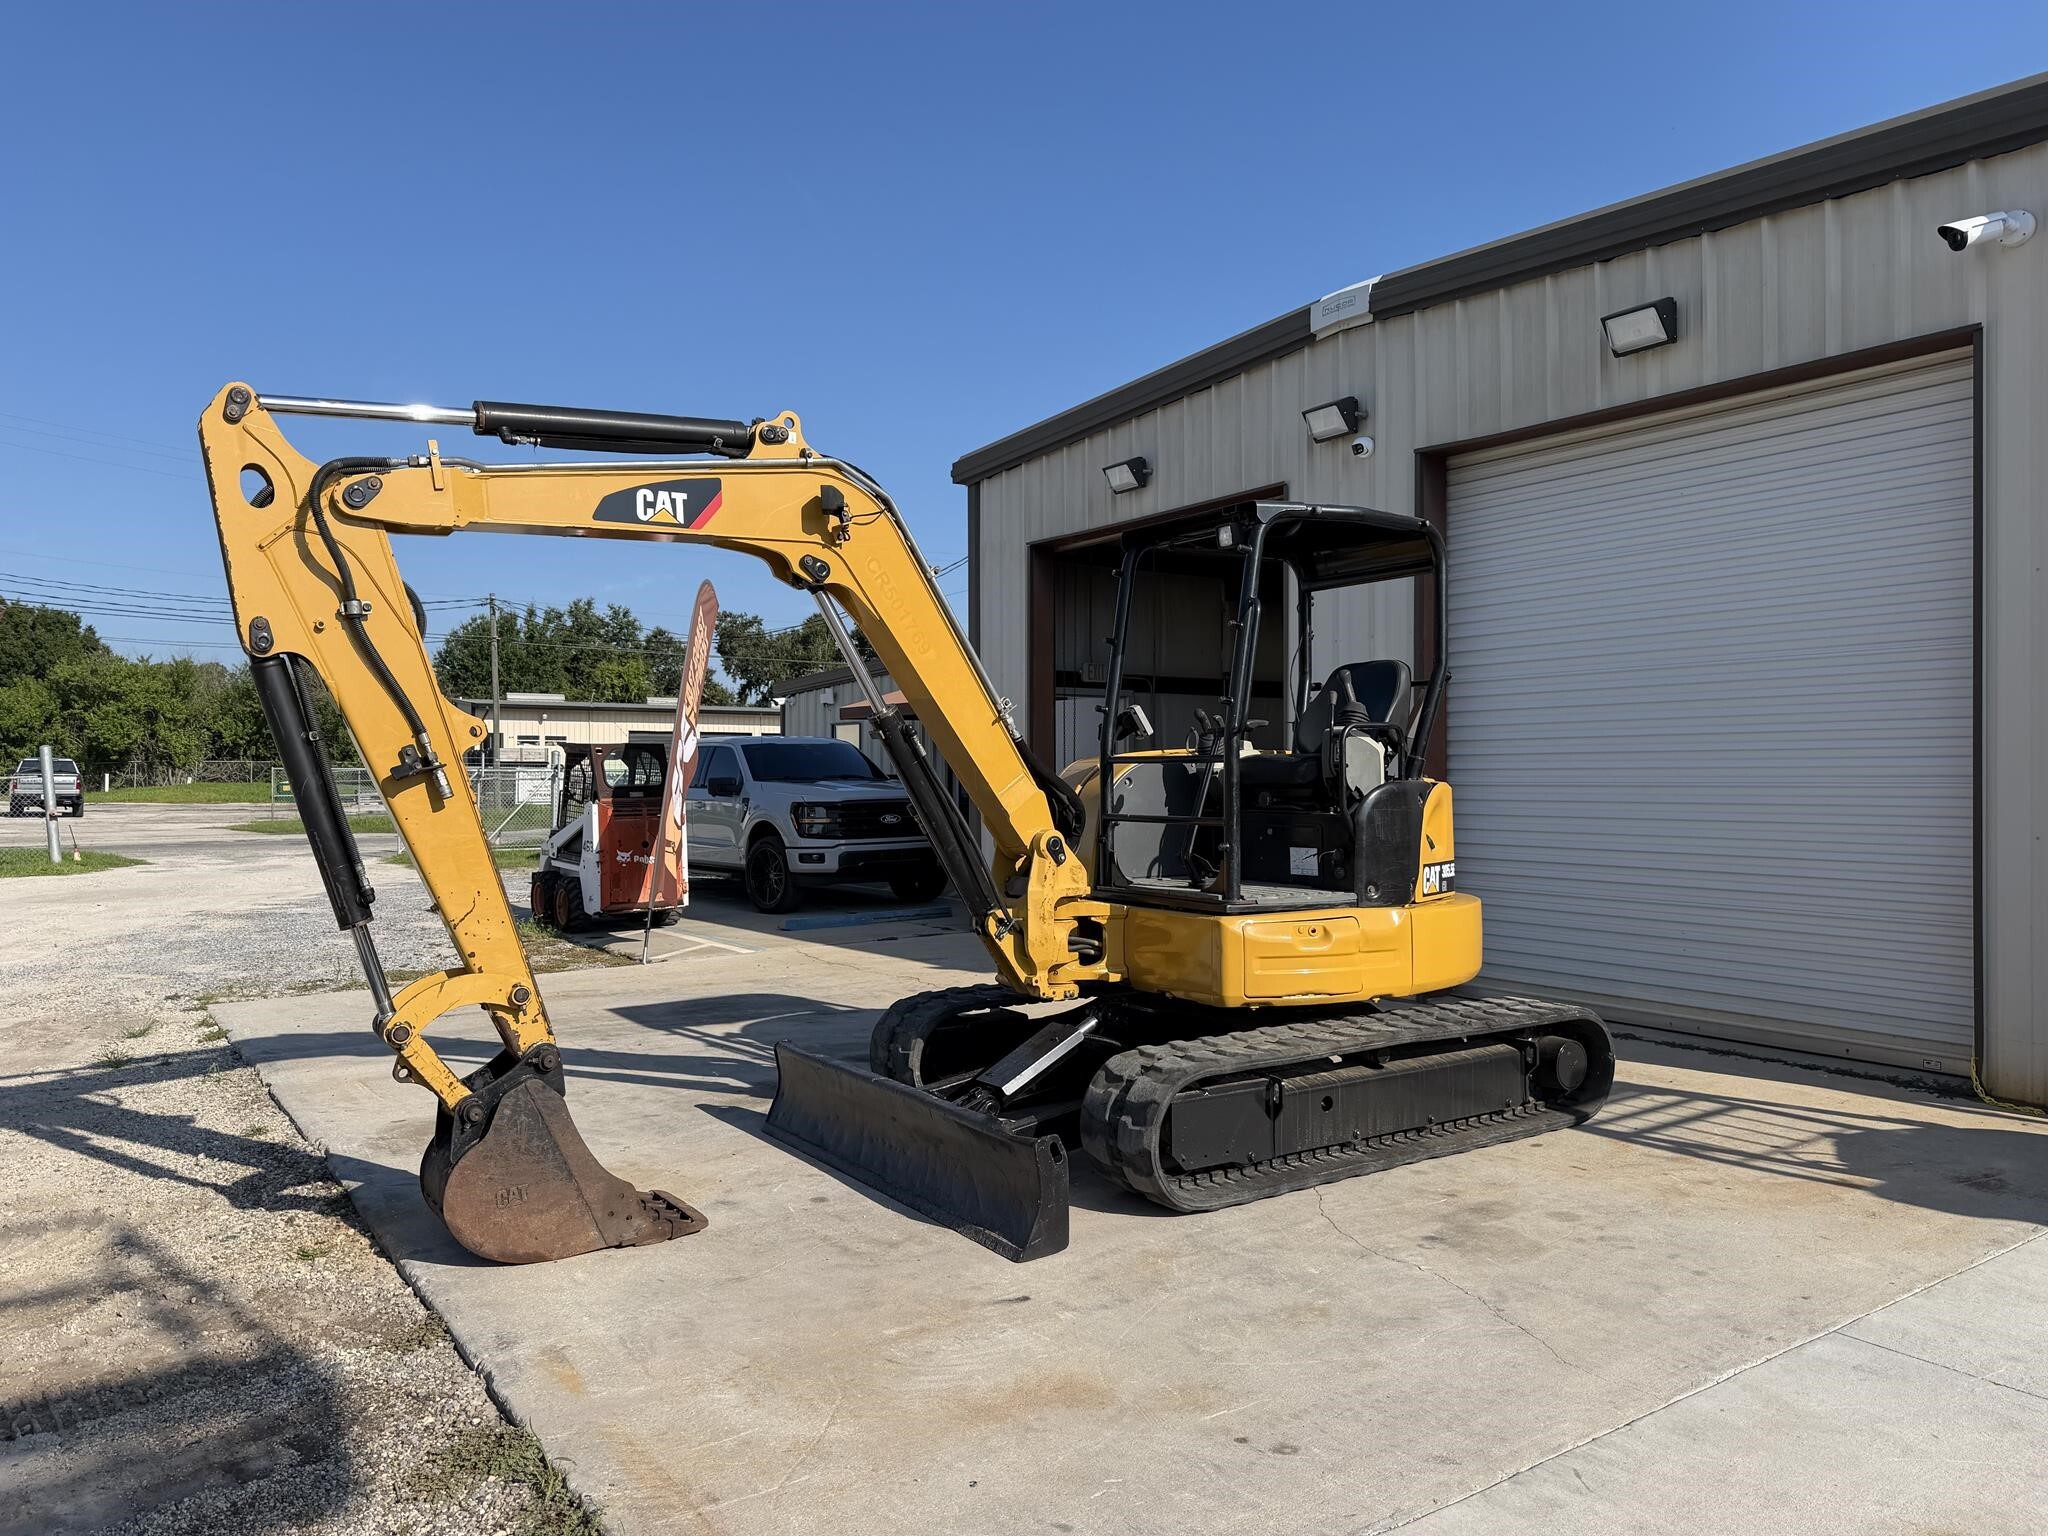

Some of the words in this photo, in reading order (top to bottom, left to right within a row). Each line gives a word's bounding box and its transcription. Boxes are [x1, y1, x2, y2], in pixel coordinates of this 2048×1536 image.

[636, 488, 688, 525] CAT
[1423, 865, 1441, 895] CAT
[496, 1184, 530, 1209] CAT
